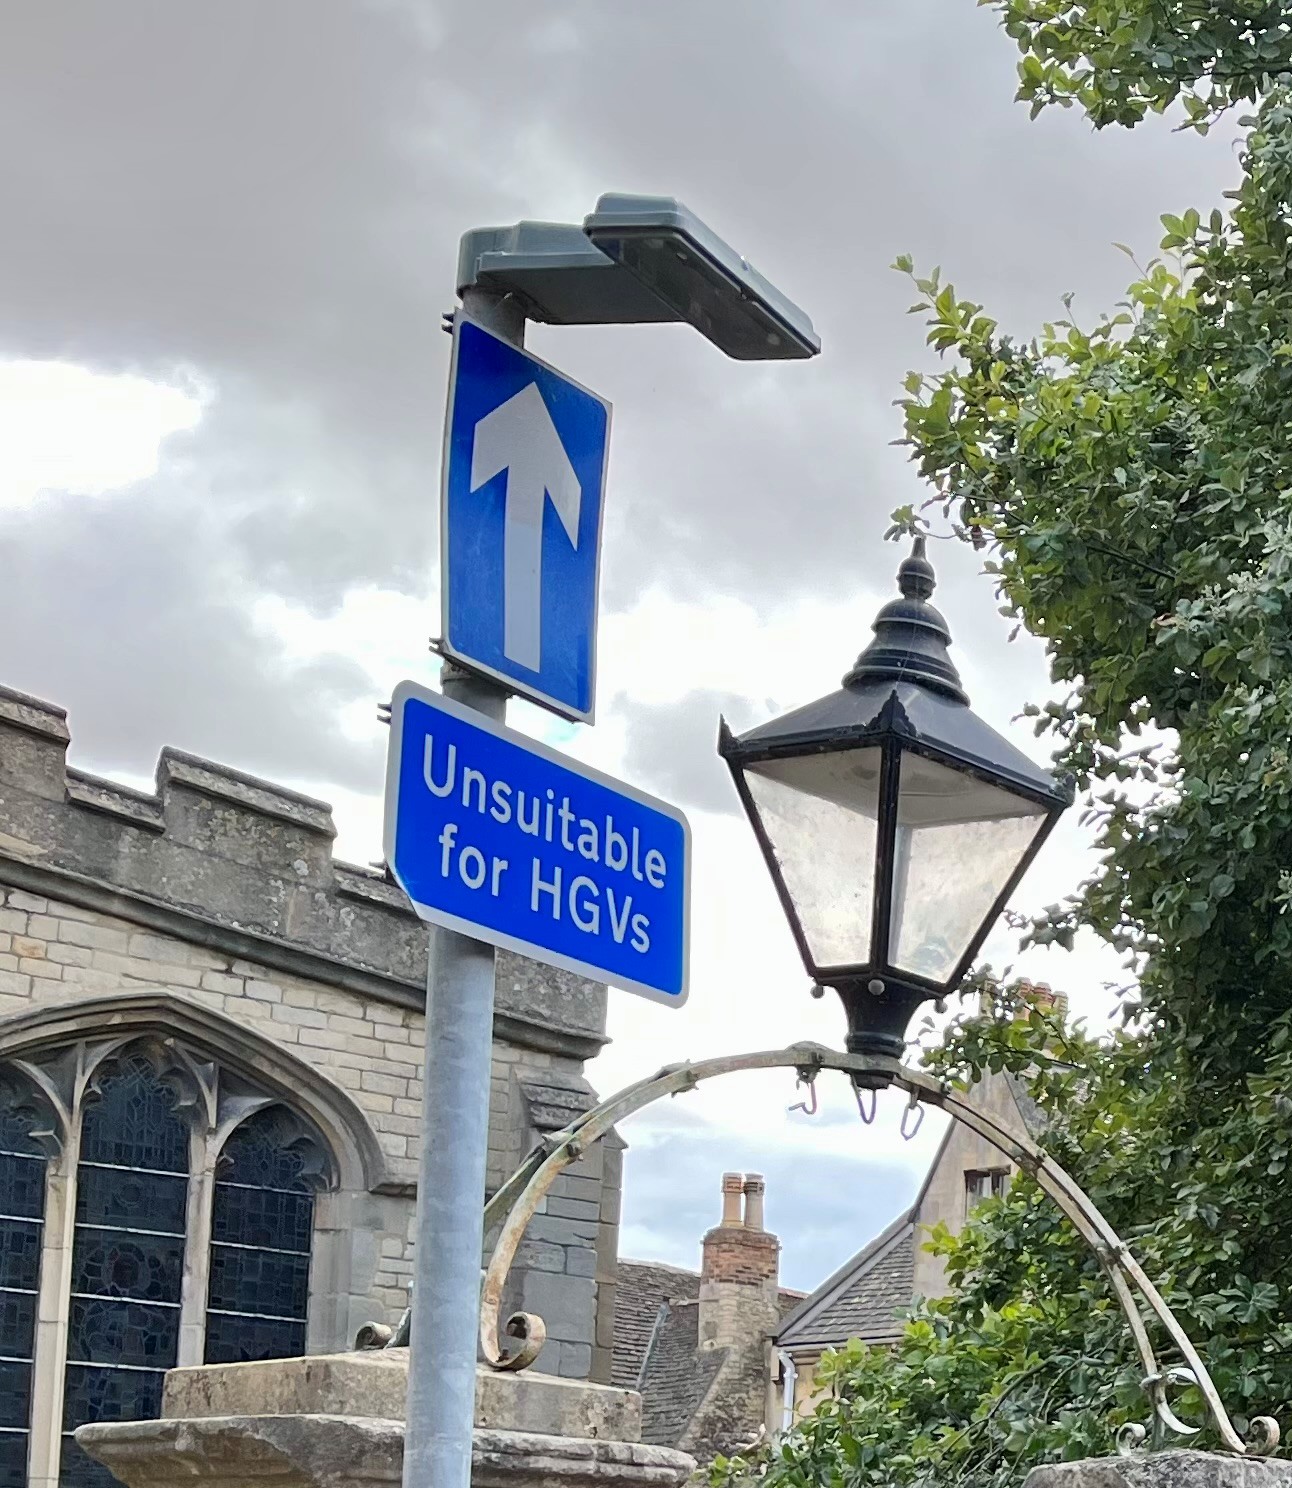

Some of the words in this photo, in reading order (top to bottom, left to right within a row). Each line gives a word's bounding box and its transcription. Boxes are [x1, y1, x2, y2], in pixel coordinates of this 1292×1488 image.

[422, 733, 667, 889] Unsuitable
[438, 823, 508, 897] for
[530, 856, 650, 954] HGVs
